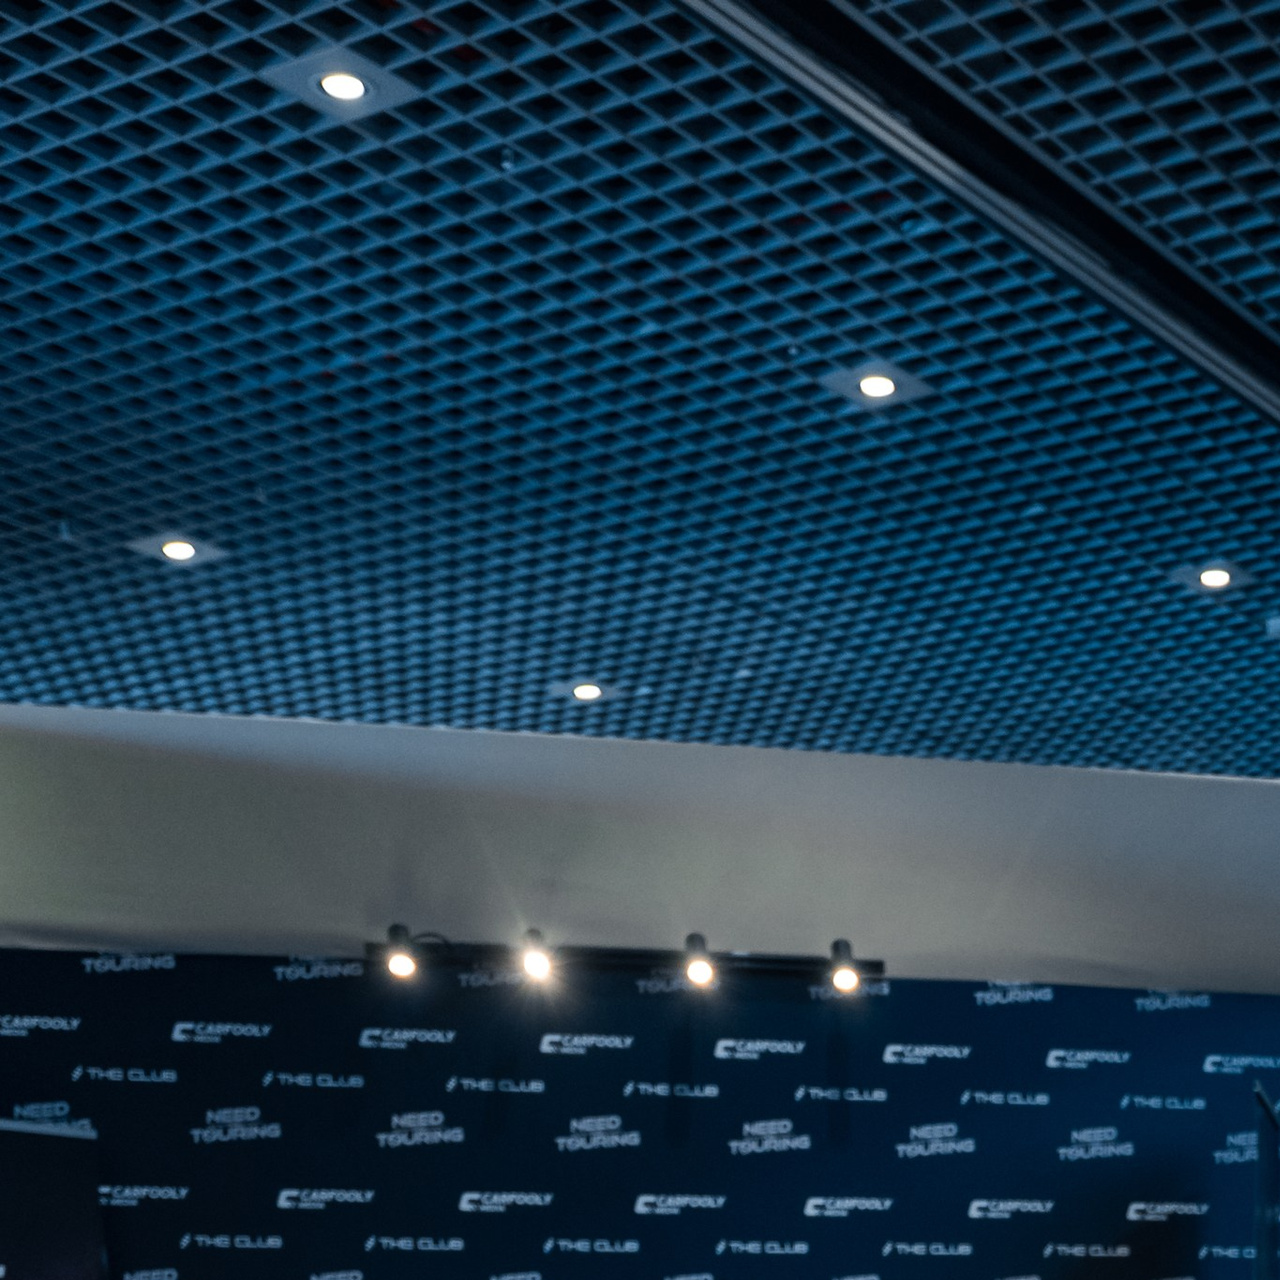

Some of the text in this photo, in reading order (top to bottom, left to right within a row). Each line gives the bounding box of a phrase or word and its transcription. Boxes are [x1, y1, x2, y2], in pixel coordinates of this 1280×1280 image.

[0, 1015, 81, 1030] CARFOOLY
[194, 1022, 272, 1037] CARFOOLY
[380, 1028, 456, 1043] CARFOOLY
[560, 1034, 634, 1049] CARFOOLY
[734, 1039, 806, 1054] CARFOOLY
[902, 1044, 971, 1058] CARFOOLY
[87, 1067, 177, 1083] THE CLUB
[278, 1072, 364, 1088] THE CLUB
[461, 1078, 545, 1093] THE CLUB
[638, 1082, 719, 1097] THE CLUB
[808, 1087, 888, 1102] THE CLUB
[974, 1091, 1050, 1105] THE CLUB
[1133, 1096, 1162, 1108] THE
[13, 1101, 70, 1119] NEED
[206, 1107, 261, 1124] NEED
[391, 1112, 445, 1130] NEED
[570, 1116, 622, 1134] NEED
[742, 1120, 792, 1137] NEED
[190, 1122, 281, 1143] TOURING
[376, 1127, 465, 1148] TOURING
[909, 1124, 958, 1140] NEED
[1227, 1131, 1258, 1147] NEE
[555, 1131, 641, 1152] TOURING
[728, 1134, 811, 1155] TOURING
[895, 1138, 976, 1158] TOURING
[112, 1185, 189, 1199] CARFOOLY
[298, 1189, 375, 1203] CARFOOLY
[480, 1191, 554, 1206] CARFOOLY
[655, 1194, 726, 1208] CARFOOLY
[823, 1197, 893, 1211] CARFOOLY
[987, 1199, 1054, 1212] CARFOOLY
[196, 1234, 283, 1249] THE CLUB
[379, 1237, 465, 1251] THE CLUB
[558, 1239, 640, 1253] THE CLUB
[729, 1240, 809, 1254] THE CLUB
[896, 1242, 973, 1256] THE CLUB
[1056, 1244, 1130, 1257] THE CLUB
[1212, 1246, 1240, 1258] THE
